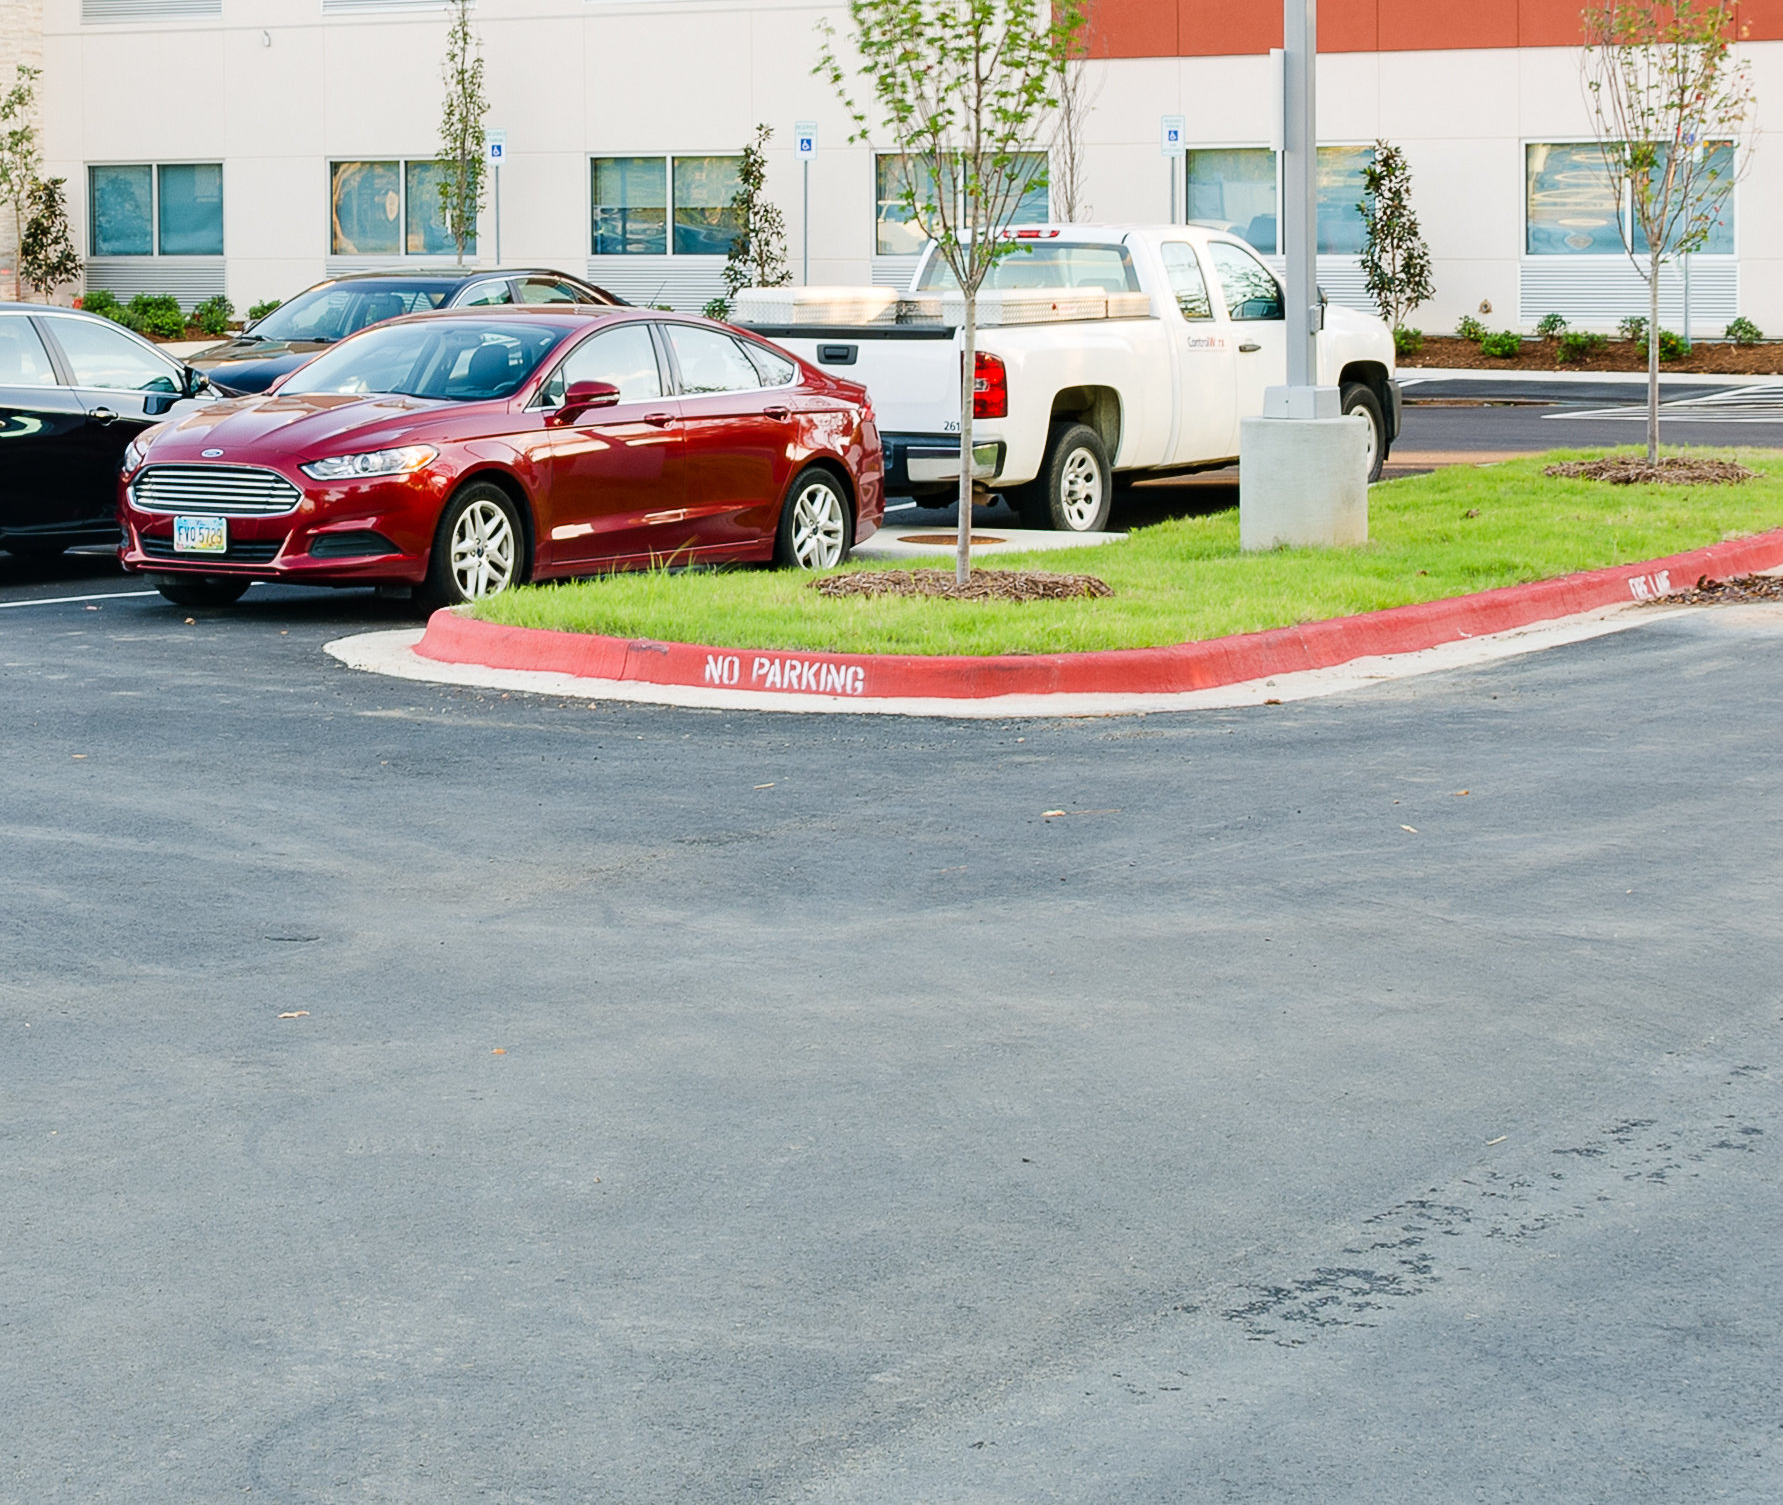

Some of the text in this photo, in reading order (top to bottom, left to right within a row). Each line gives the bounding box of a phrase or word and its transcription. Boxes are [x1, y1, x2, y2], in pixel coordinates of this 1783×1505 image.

[944, 421, 960, 431] 261
[198, 526, 222, 545] 5729
[704, 654, 865, 695] NO PARKING
